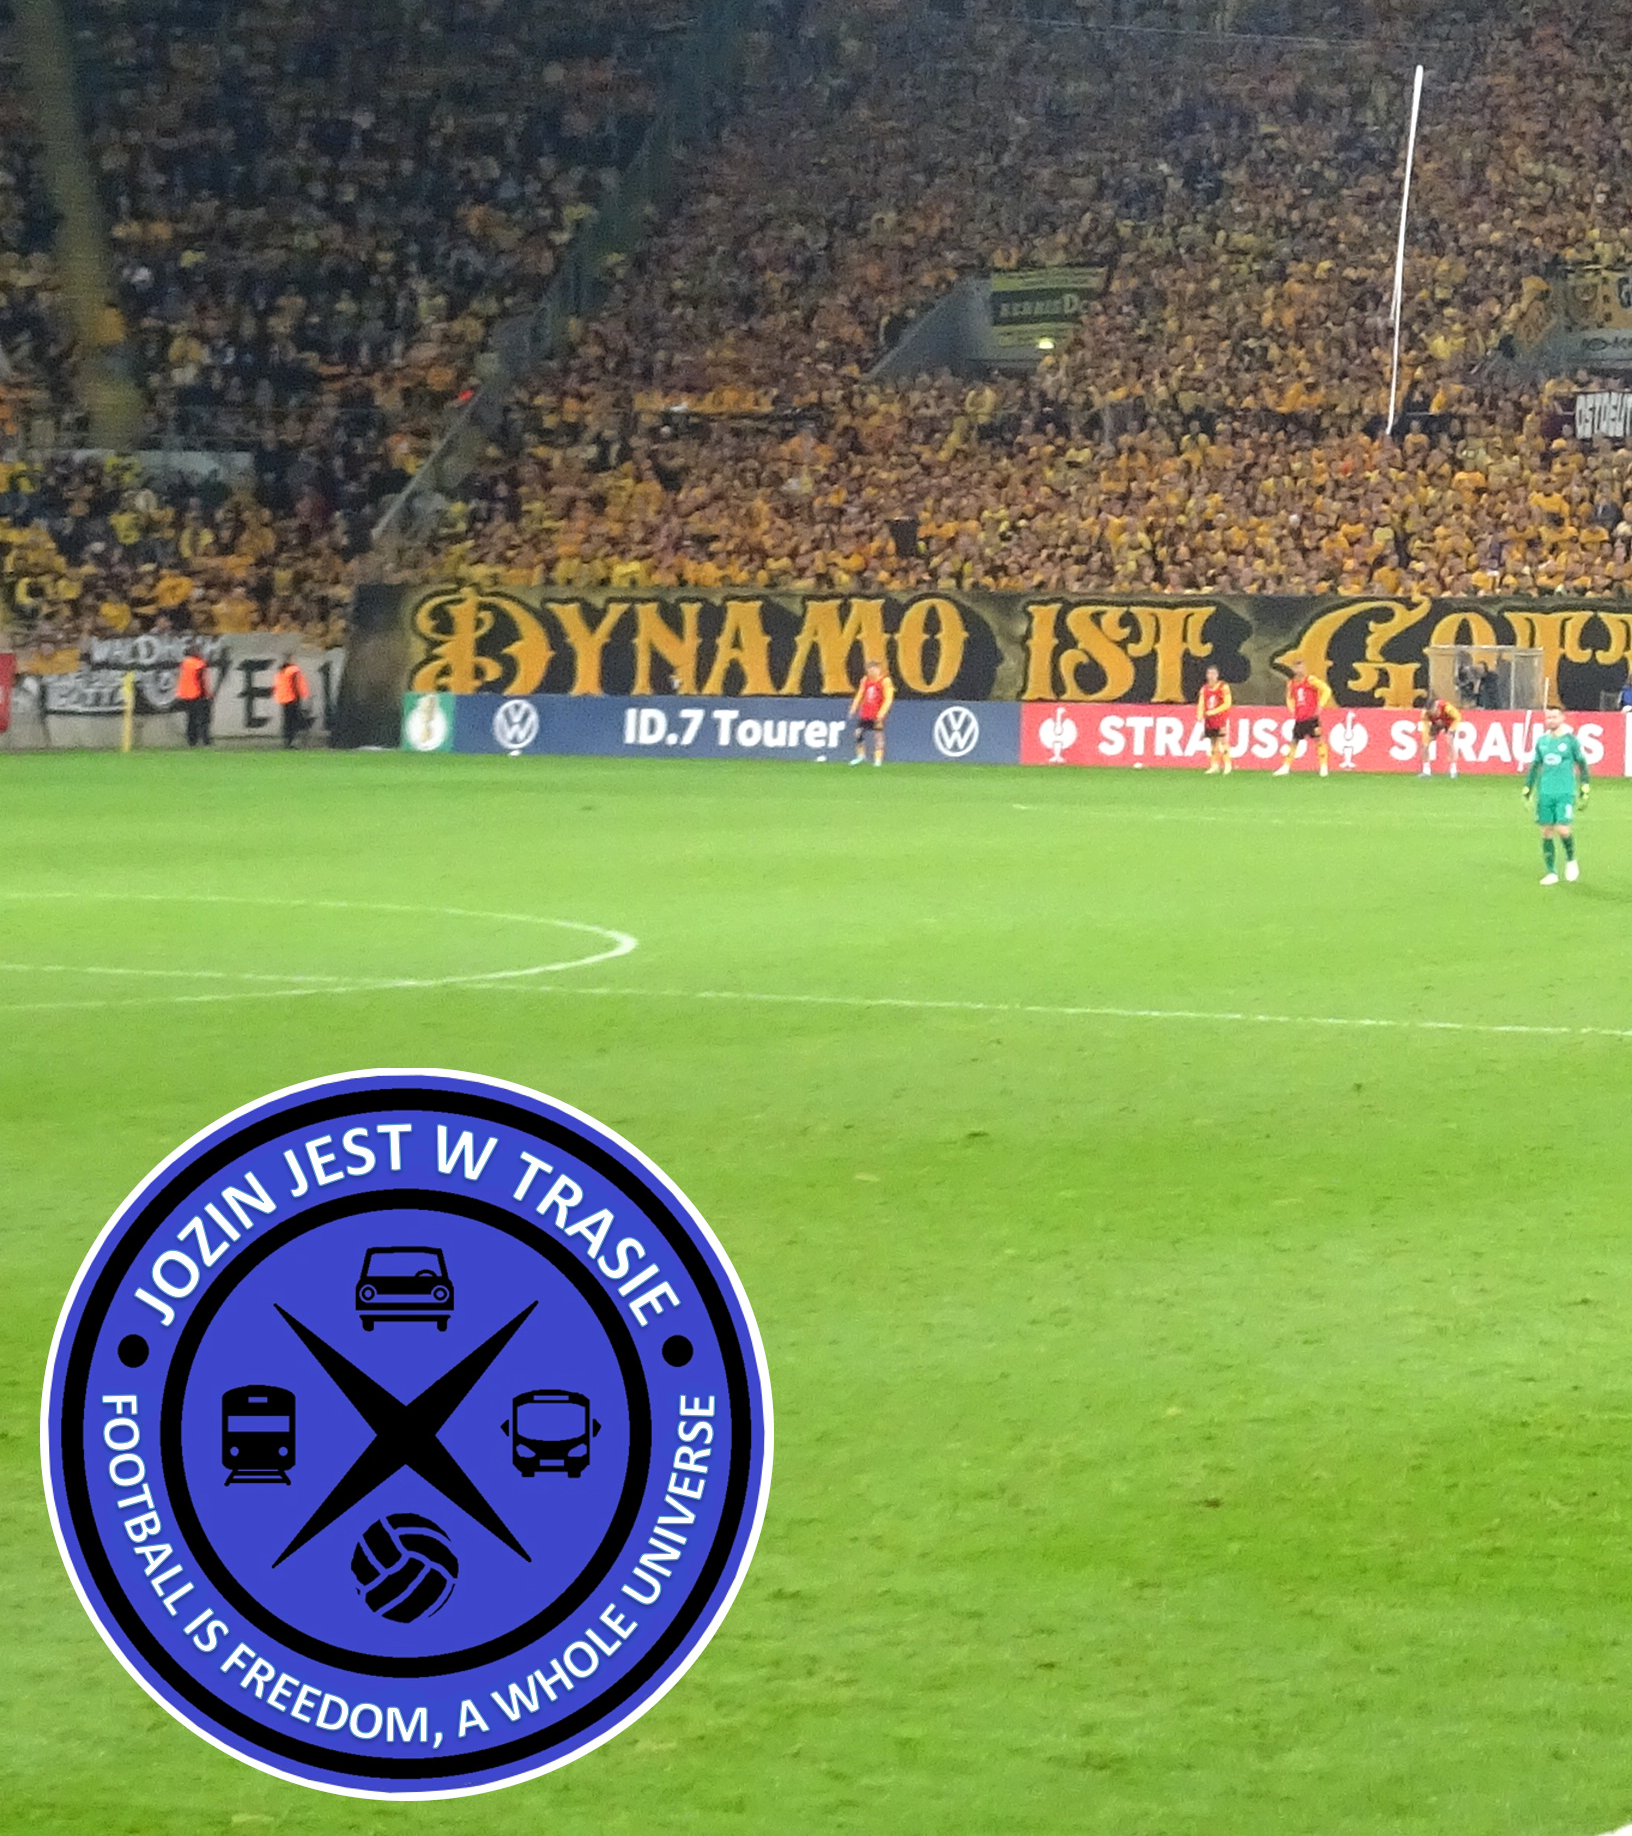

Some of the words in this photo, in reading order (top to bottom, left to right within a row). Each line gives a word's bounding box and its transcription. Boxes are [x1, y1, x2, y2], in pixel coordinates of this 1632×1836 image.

[412, 588, 970, 696] DYNAMO
[1021, 603, 1215, 703] IST
[624, 707, 702, 746] ID.7
[711, 709, 847, 749] Tourer
